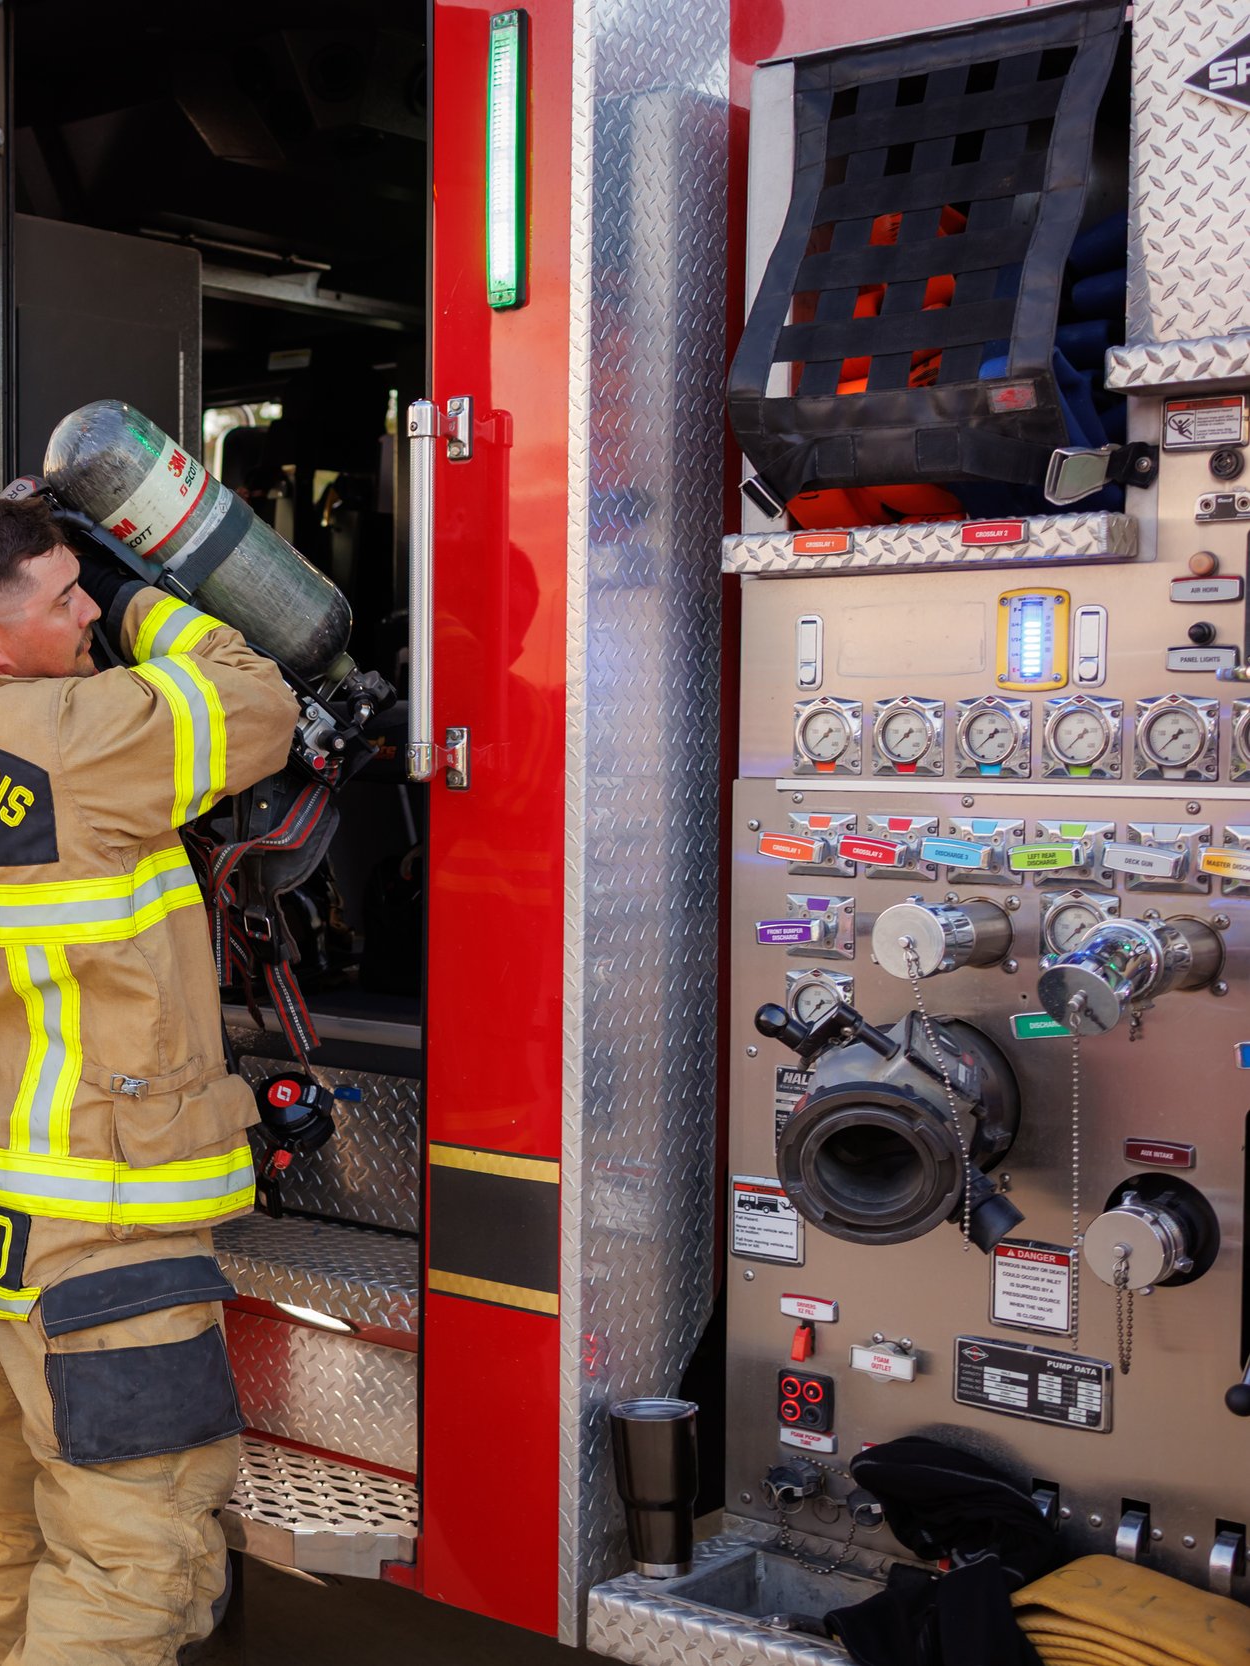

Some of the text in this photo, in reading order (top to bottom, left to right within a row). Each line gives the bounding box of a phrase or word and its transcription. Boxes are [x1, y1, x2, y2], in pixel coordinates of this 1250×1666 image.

[167, 448, 187, 478] 3M
[126, 525, 153, 549] COTT
[805, 541, 830, 549] CROSSLAY
[772, 844, 797, 854] CROSSLAY
[852, 847, 878, 857] CROSSLAY
[935, 849, 964, 860] DISCHARGE
[1124, 857, 1140, 865] DECK
[1206, 860, 1231, 868] MASTER
[783, 1072, 812, 1085] HAL
[1140, 1149, 1174, 1160] AUX INTAKE
[1017, 1250, 1056, 1263] DANGER
[997, 1261, 1020, 1269] SERIOUS
[1002, 1271, 1020, 1279] COULD
[1015, 1283, 1041, 1291] SUPPLIED
[1002, 1290, 1061, 1304] PRESSURIZED SOURCE
[796, 1301, 817, 1310] DRIVERS
[873, 1355, 890, 1364] FOAM
[870, 1363, 892, 1372] OUTLET
[1046, 1360, 1098, 1375] PUMP DATA
[804, 1434, 822, 1442] PICKUP
